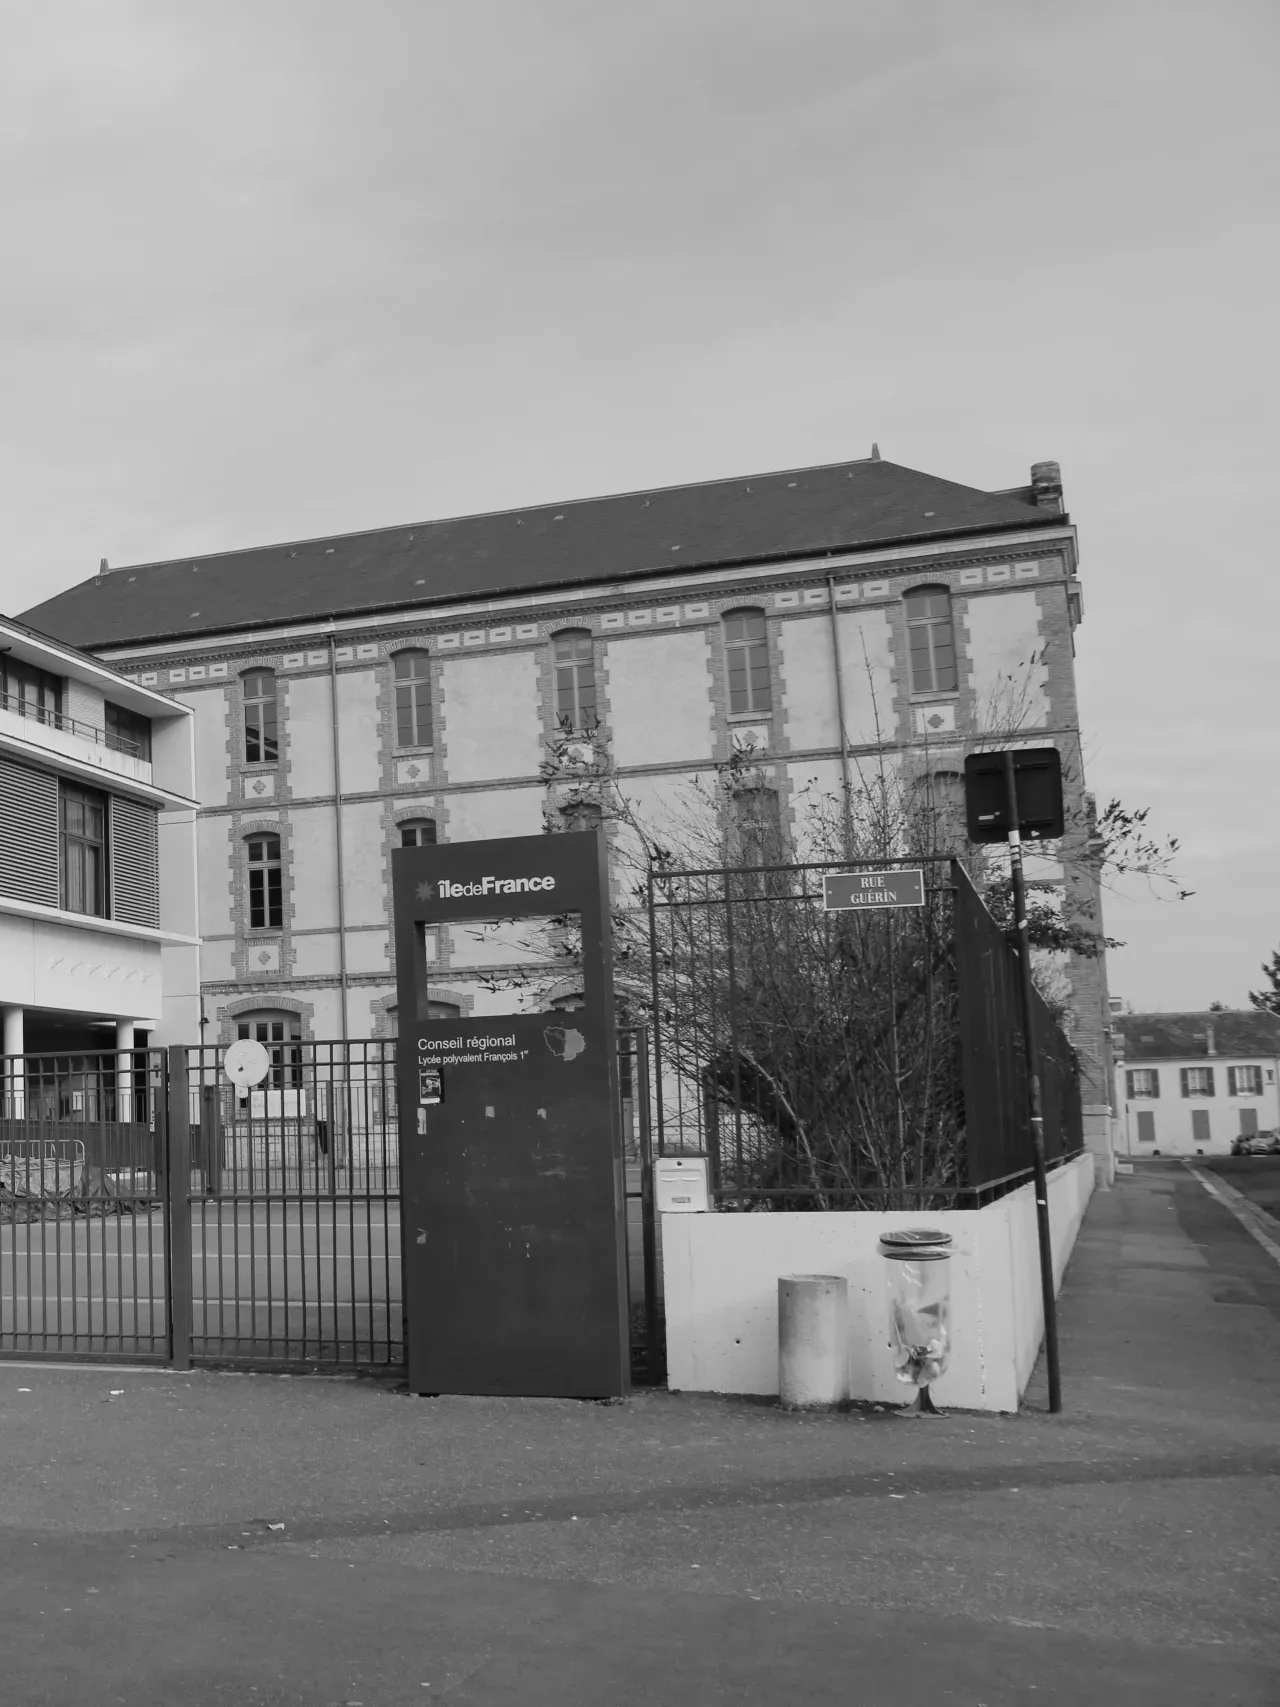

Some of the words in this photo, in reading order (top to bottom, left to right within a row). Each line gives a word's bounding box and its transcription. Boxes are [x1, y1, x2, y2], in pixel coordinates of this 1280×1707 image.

[860, 876, 885, 888] RUE
[418, 1037, 463, 1050] Conseil
[466, 1034, 516, 1050] régional
[418, 1055, 441, 1067] Lycée
[443, 1053, 482, 1065] polyvalent
[484, 1051, 518, 1062] François
